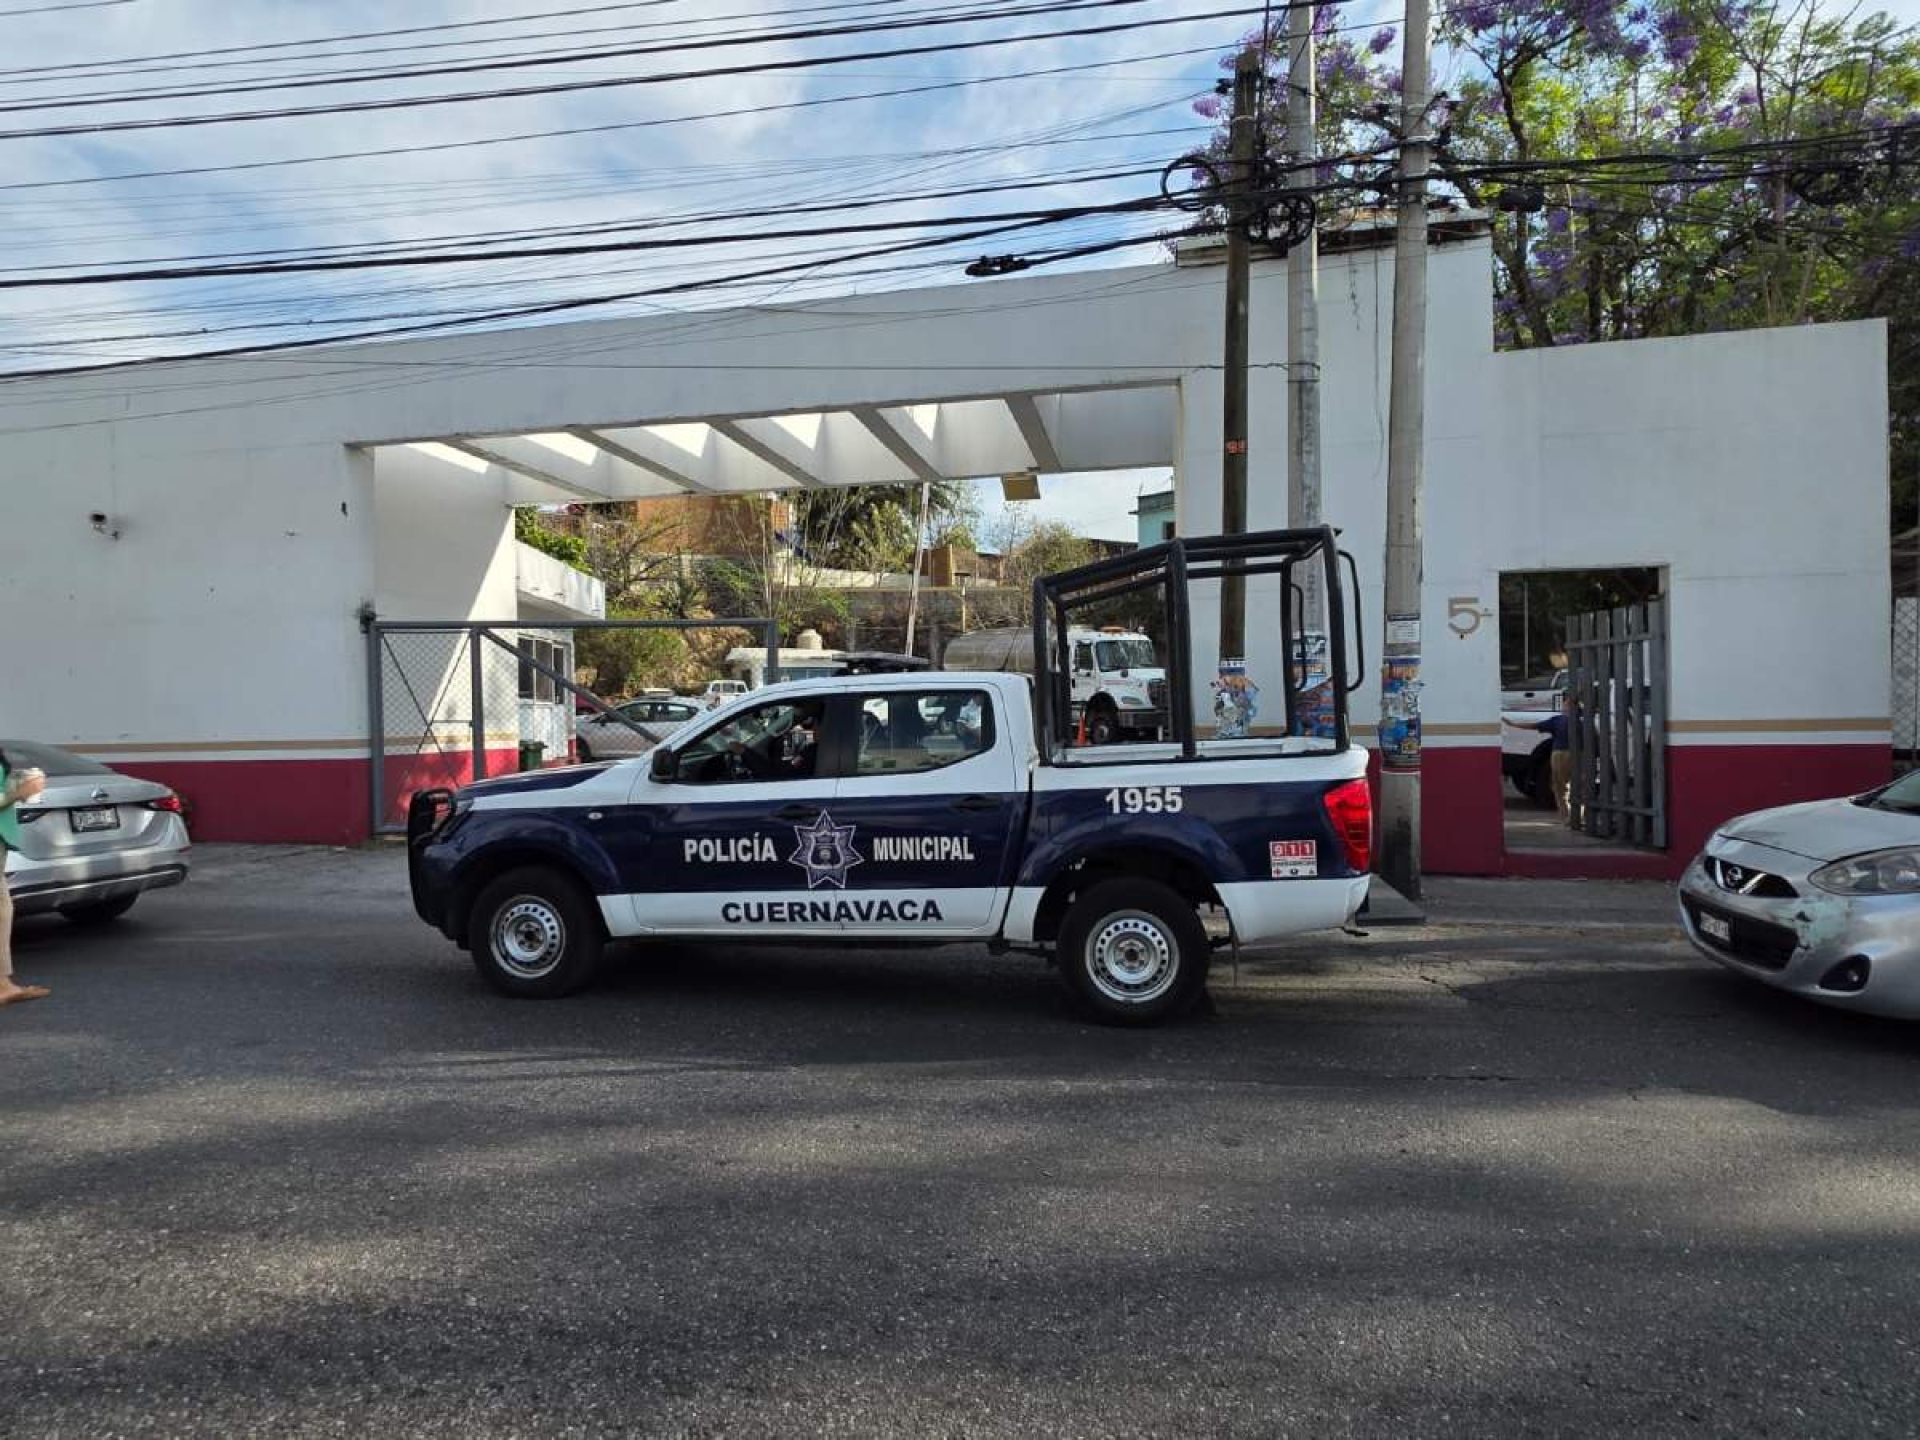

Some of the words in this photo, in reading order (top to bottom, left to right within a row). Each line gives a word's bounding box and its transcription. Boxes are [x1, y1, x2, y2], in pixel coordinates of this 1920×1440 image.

[1448, 597, 1480, 634] 5
[1105, 786, 1183, 814] 1955
[684, 832, 778, 862] POLICÍA
[873, 836, 974, 861] MUNICIPAL
[1274, 842, 1311, 856] 911
[721, 900, 943, 923] CUERNAVACA
